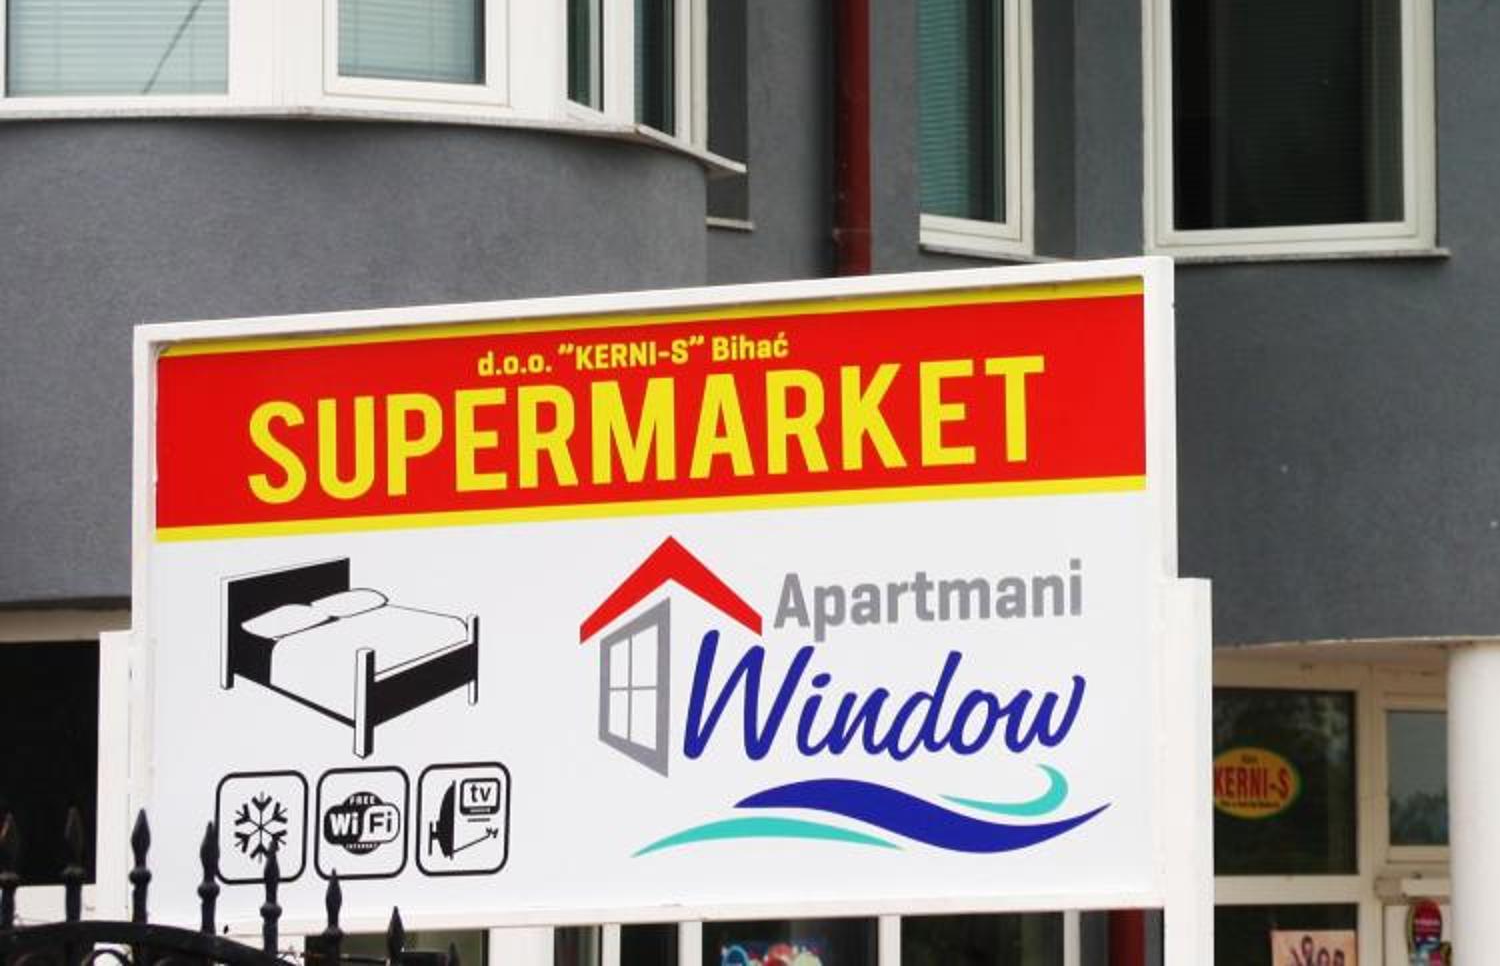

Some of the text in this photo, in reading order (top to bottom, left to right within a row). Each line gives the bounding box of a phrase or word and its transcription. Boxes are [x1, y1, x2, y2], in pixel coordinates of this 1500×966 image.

[477, 350, 553, 376] d.o.o.
[711, 331, 789, 362] Bihać
[248, 355, 1045, 504] SUPERMARKET
[773, 558, 1083, 642] Apartmani
[683, 629, 1086, 761] Window
